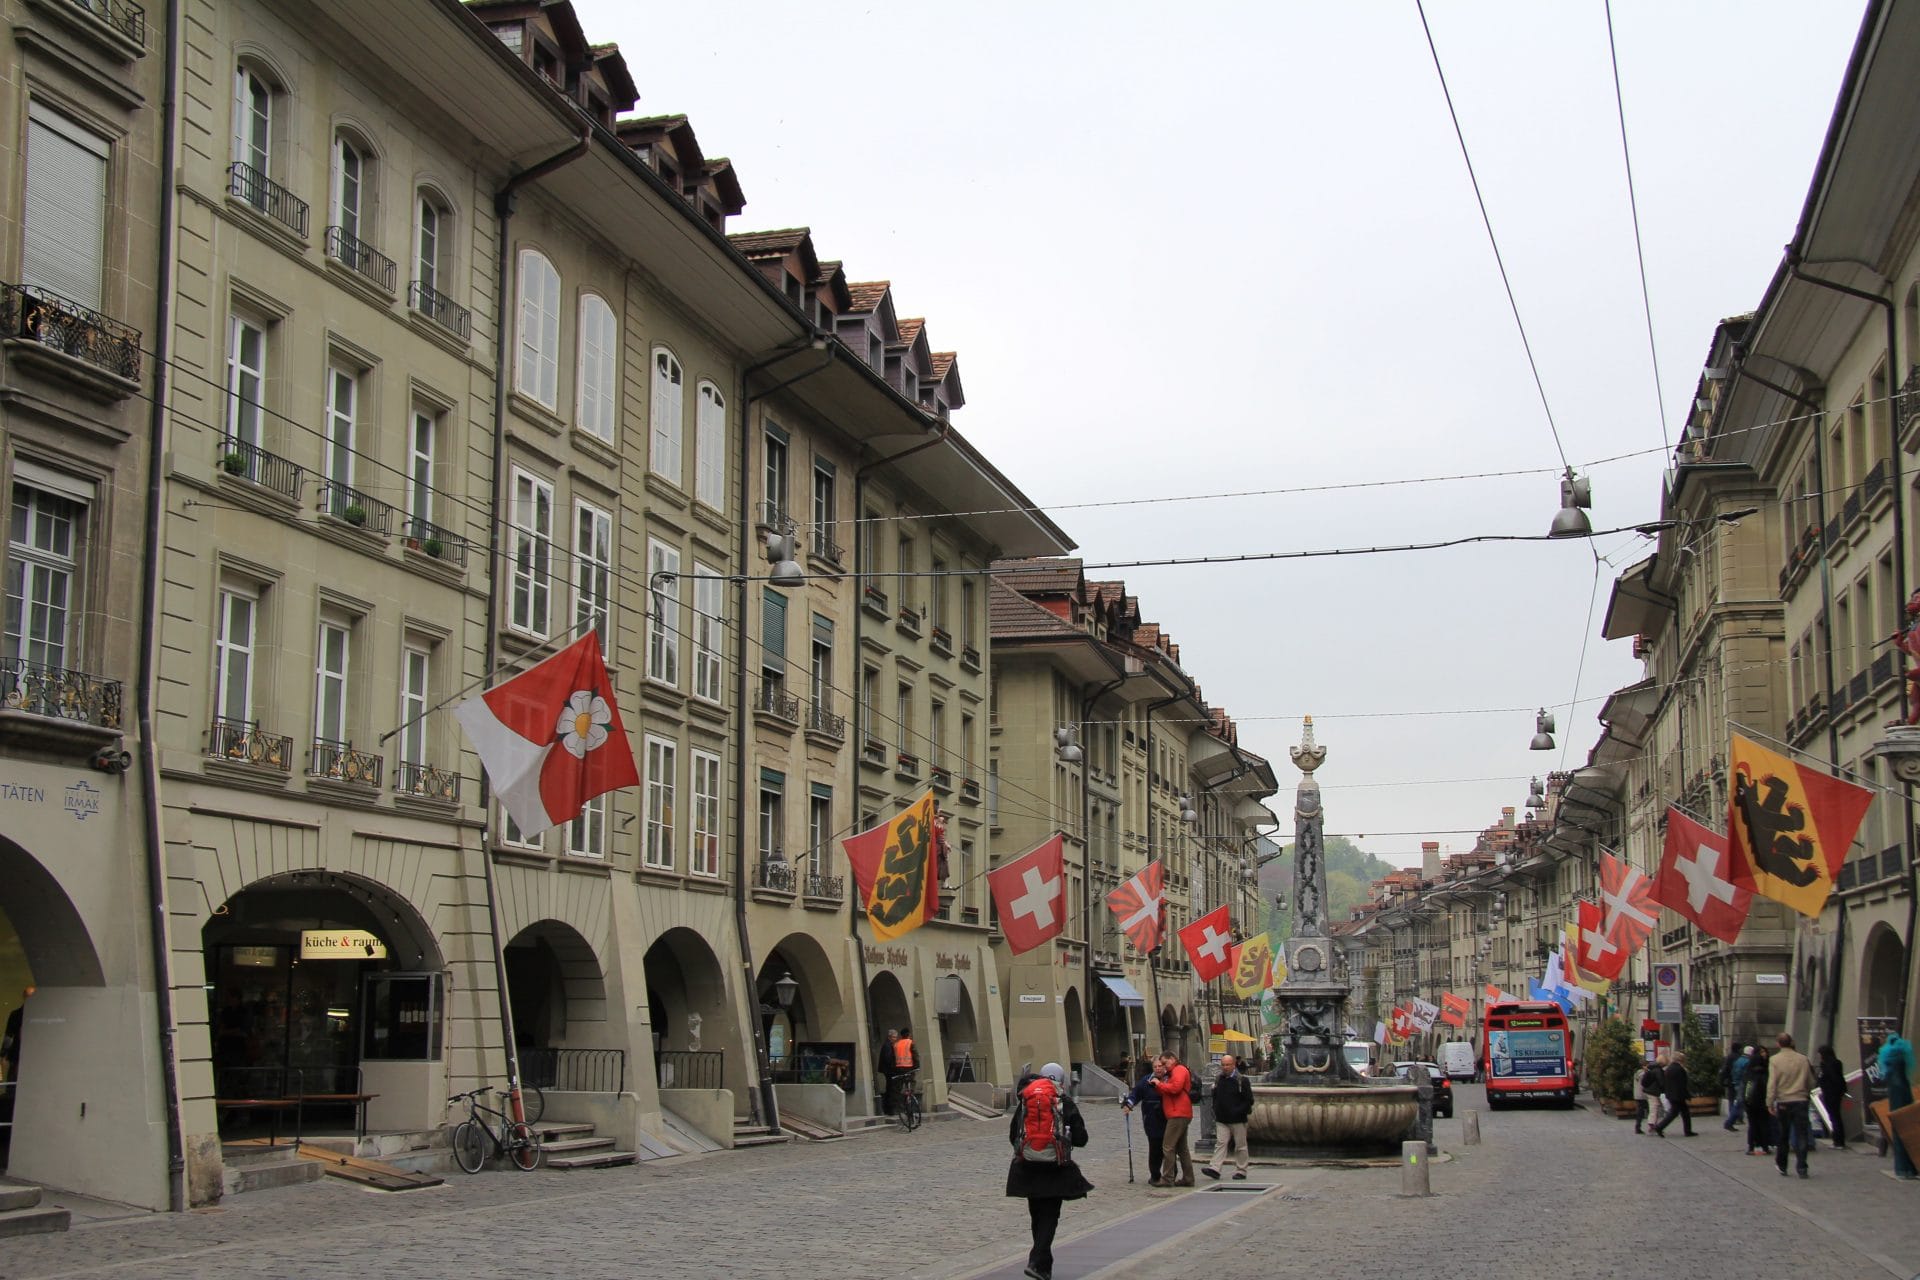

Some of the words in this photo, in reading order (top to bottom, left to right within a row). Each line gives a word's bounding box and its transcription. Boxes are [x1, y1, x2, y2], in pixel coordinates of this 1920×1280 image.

[1, 782, 44, 802] TÄTEN
[64, 796, 99, 809] IRMAK
[305, 936, 338, 947] küche
[341, 936, 350, 947] &
